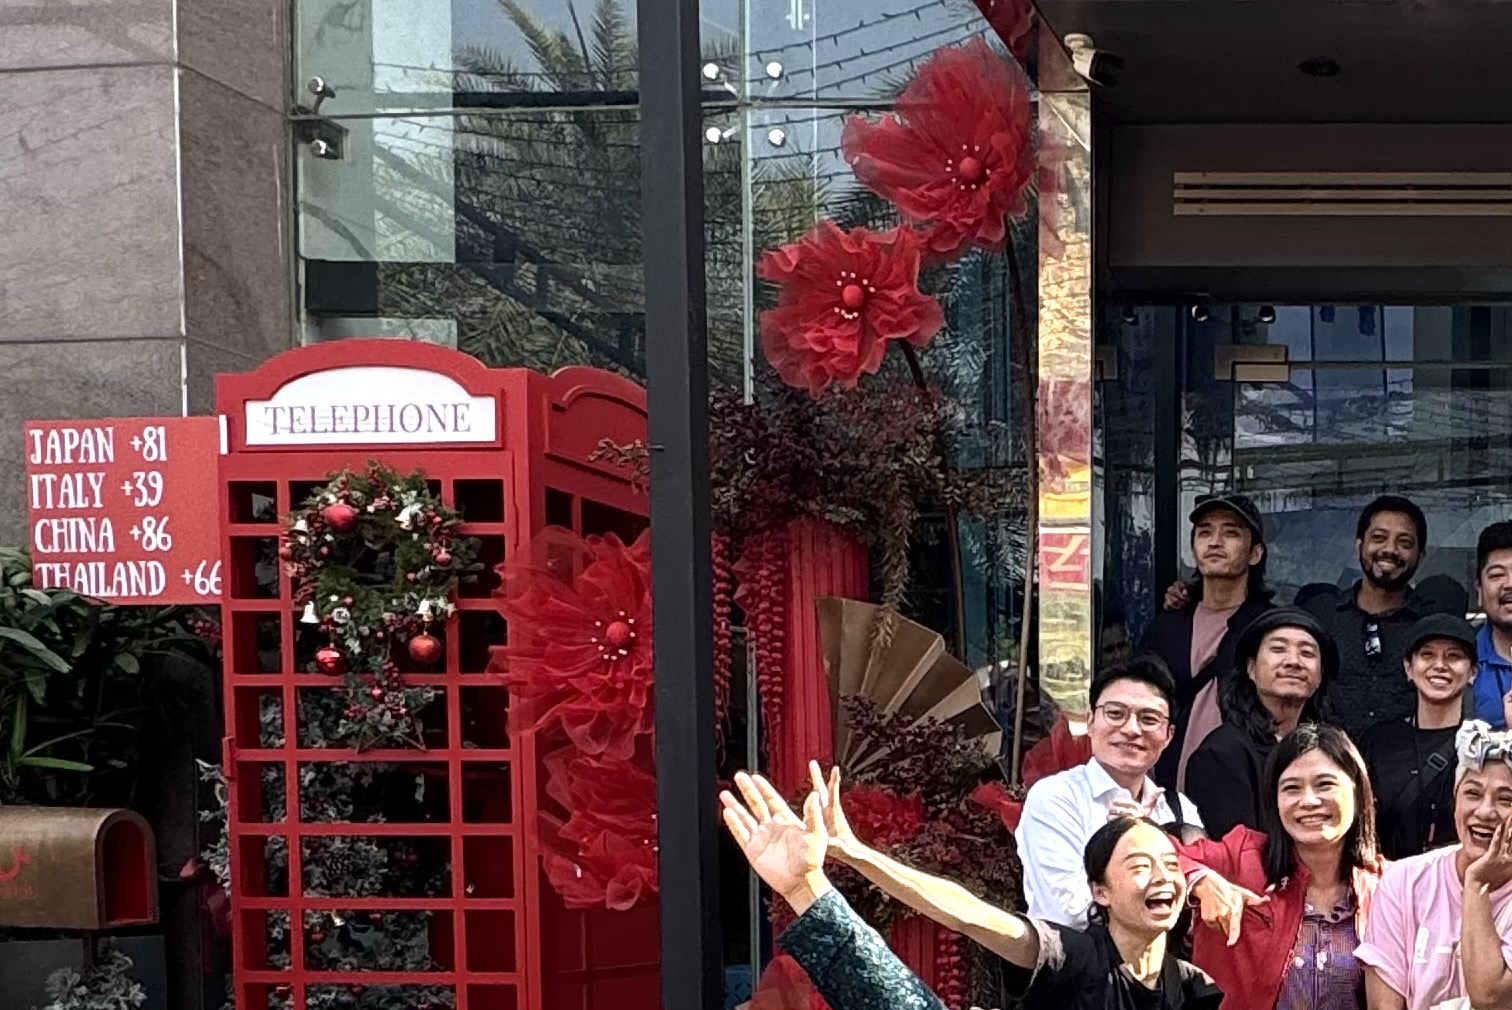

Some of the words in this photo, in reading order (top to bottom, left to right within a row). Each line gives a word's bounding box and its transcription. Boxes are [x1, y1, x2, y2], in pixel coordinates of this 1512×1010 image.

[264, 403, 471, 435] TELEPHONE
[29, 427, 115, 465] JAPAN
[130, 426, 168, 462] +81
[30, 472, 106, 510] ITALY
[120, 471, 164, 507] +39
[34, 517, 115, 553] CHINA
[129, 516, 172, 551] +86
[35, 560, 166, 597] THAILAND
